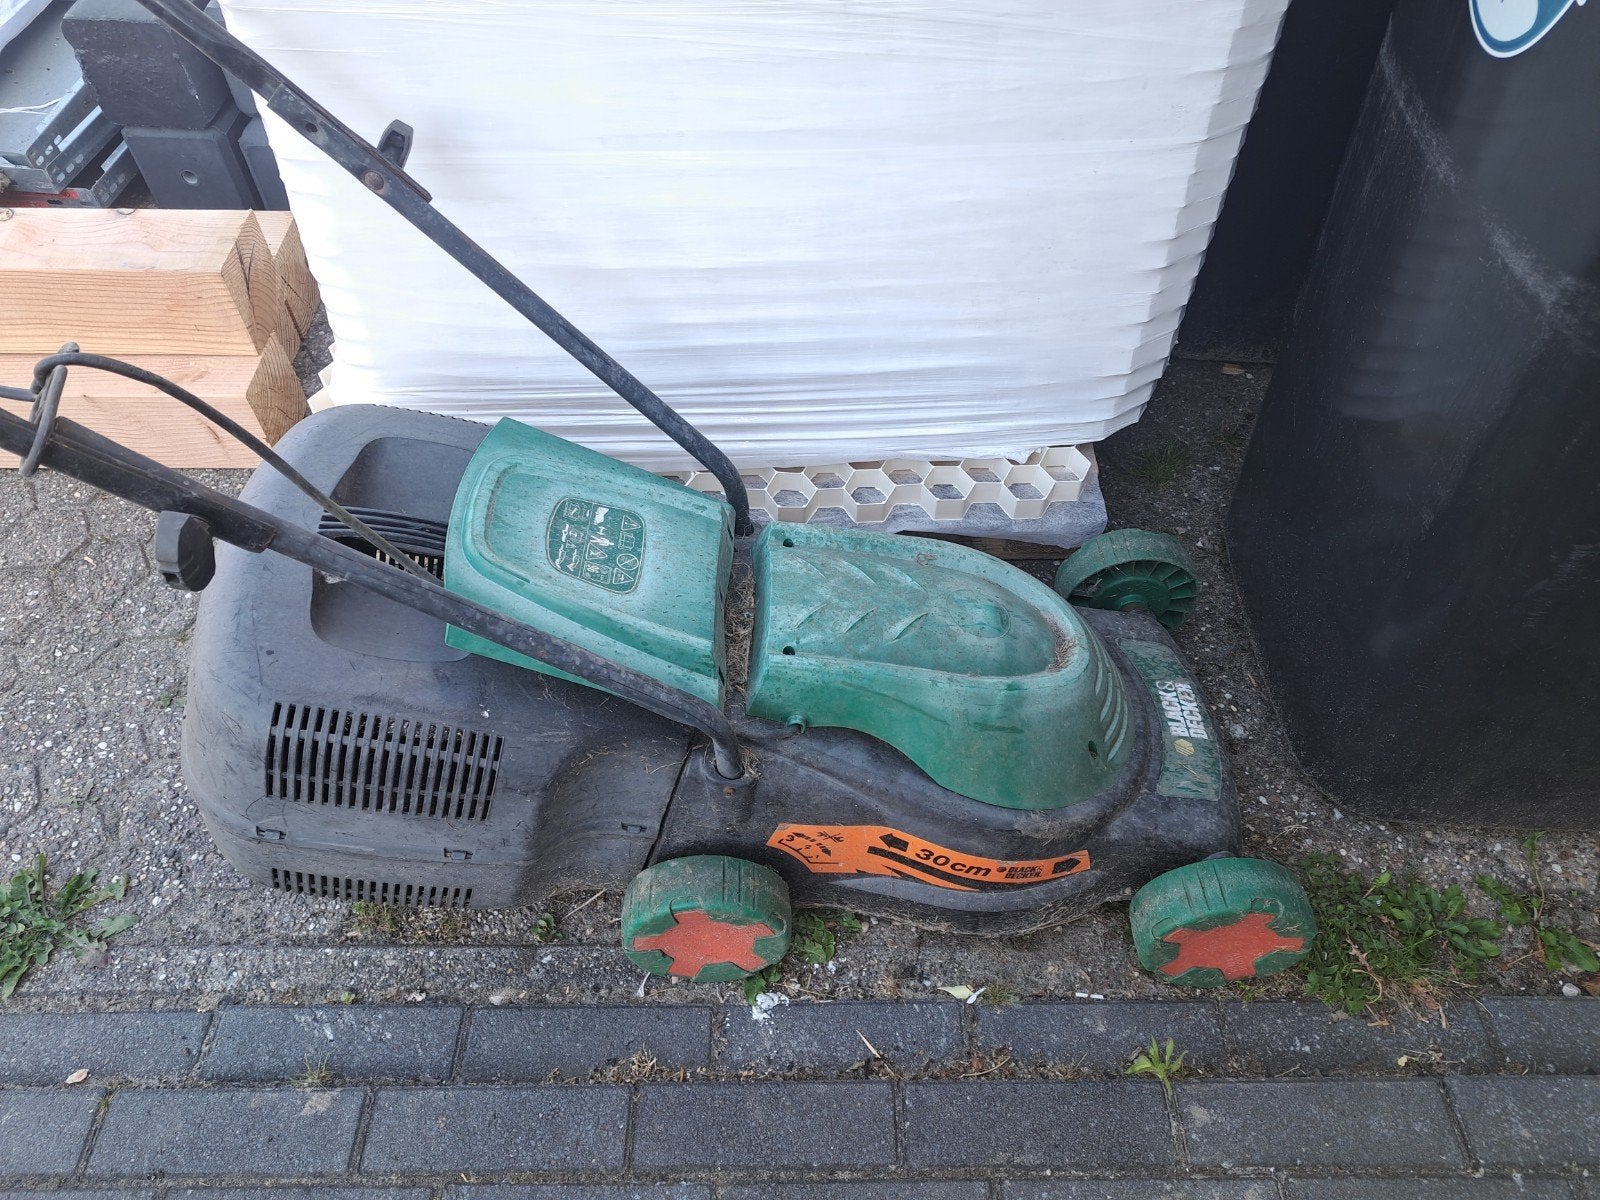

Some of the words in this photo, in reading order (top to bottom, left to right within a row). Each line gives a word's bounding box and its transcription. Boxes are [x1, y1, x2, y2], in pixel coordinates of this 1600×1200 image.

[1174, 682, 1208, 740] DECKER
[785, 834, 795, 842] 3
[915, 848, 992, 877] 30cm
